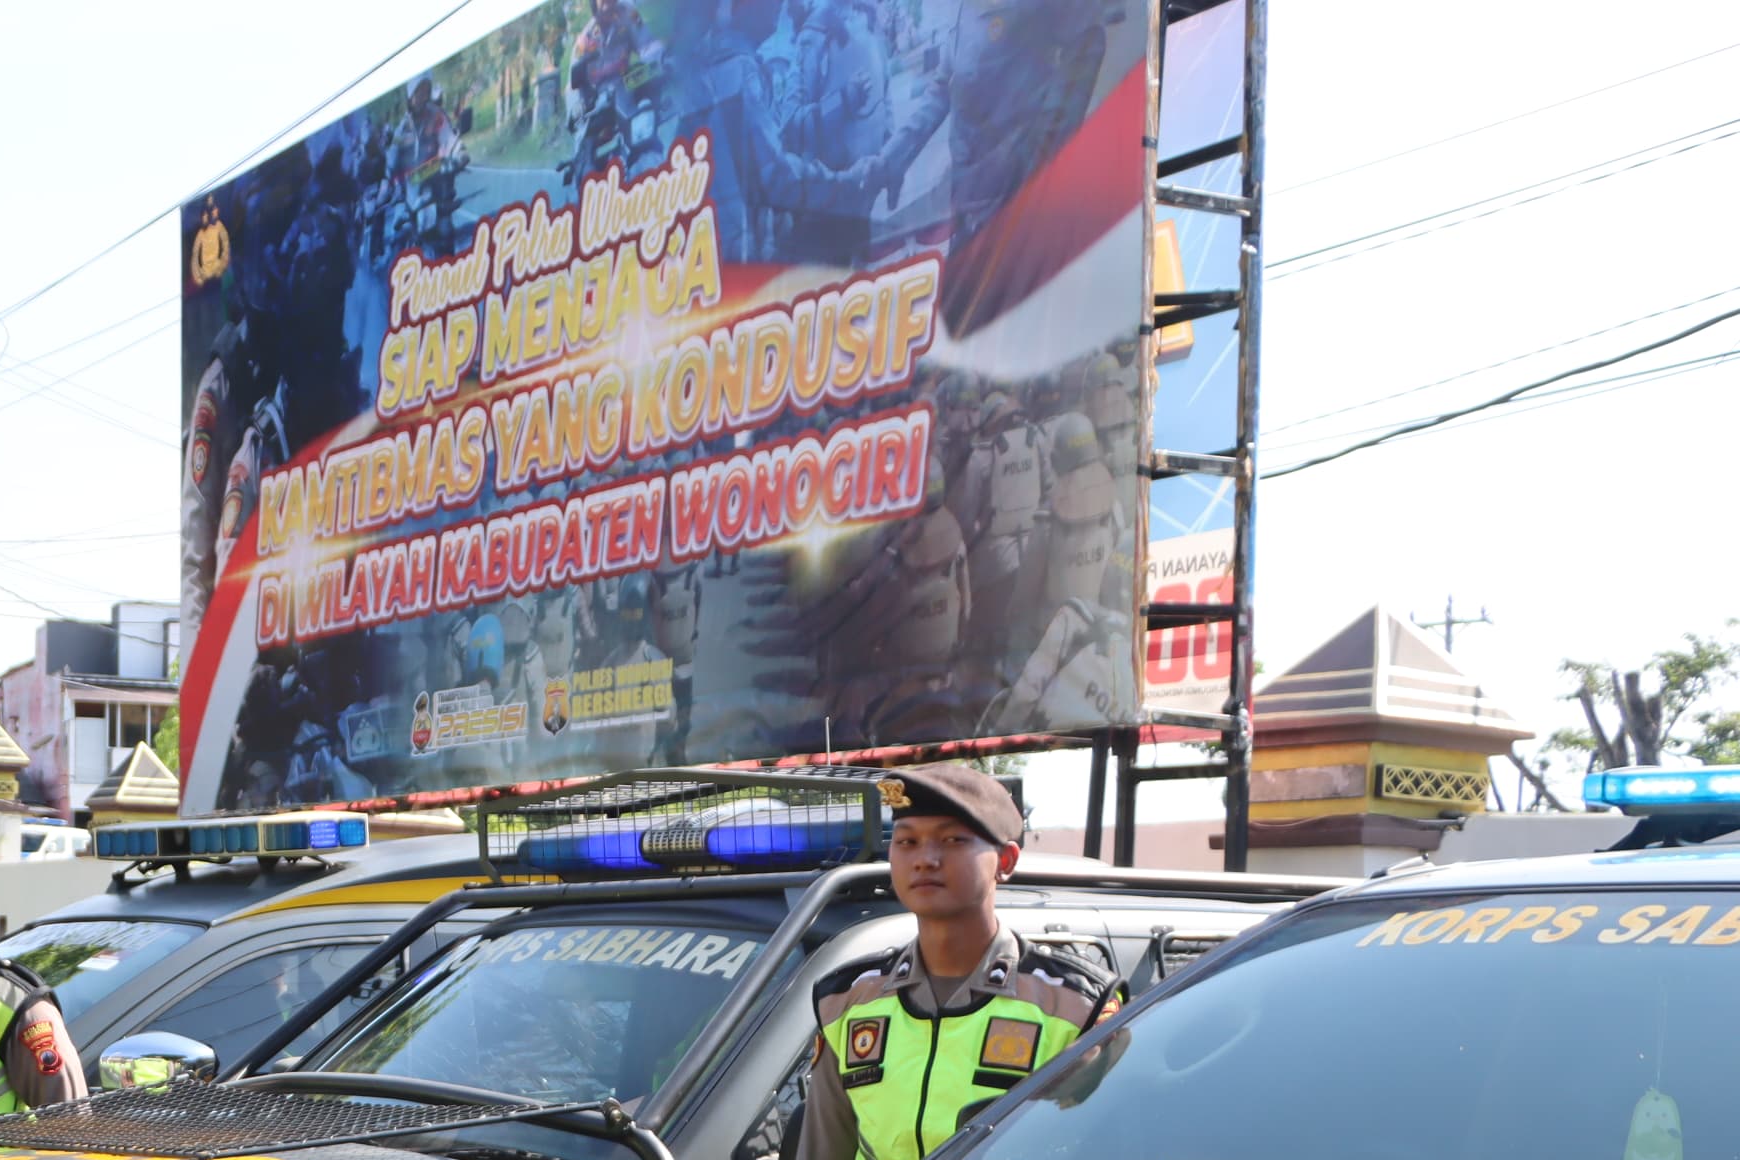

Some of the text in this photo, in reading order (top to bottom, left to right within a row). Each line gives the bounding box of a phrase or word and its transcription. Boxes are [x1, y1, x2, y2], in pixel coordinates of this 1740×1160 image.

[393, 137, 712, 326] Personel Polres Wonogiri
[379, 206, 722, 414] SIAP MENJAGA
[259, 262, 940, 554] KAMTIBMAS YANG KONDUSIF
[257, 410, 931, 646] DI WILAYAH KABUPATEN WONOGIRI
[571, 681, 673, 720] BERSINERGI
[573, 666, 614, 692] POLRES
[436, 703, 528, 738] PRESISI
[1356, 904, 1599, 948] KORPS
[542, 928, 758, 980] SABHARA
